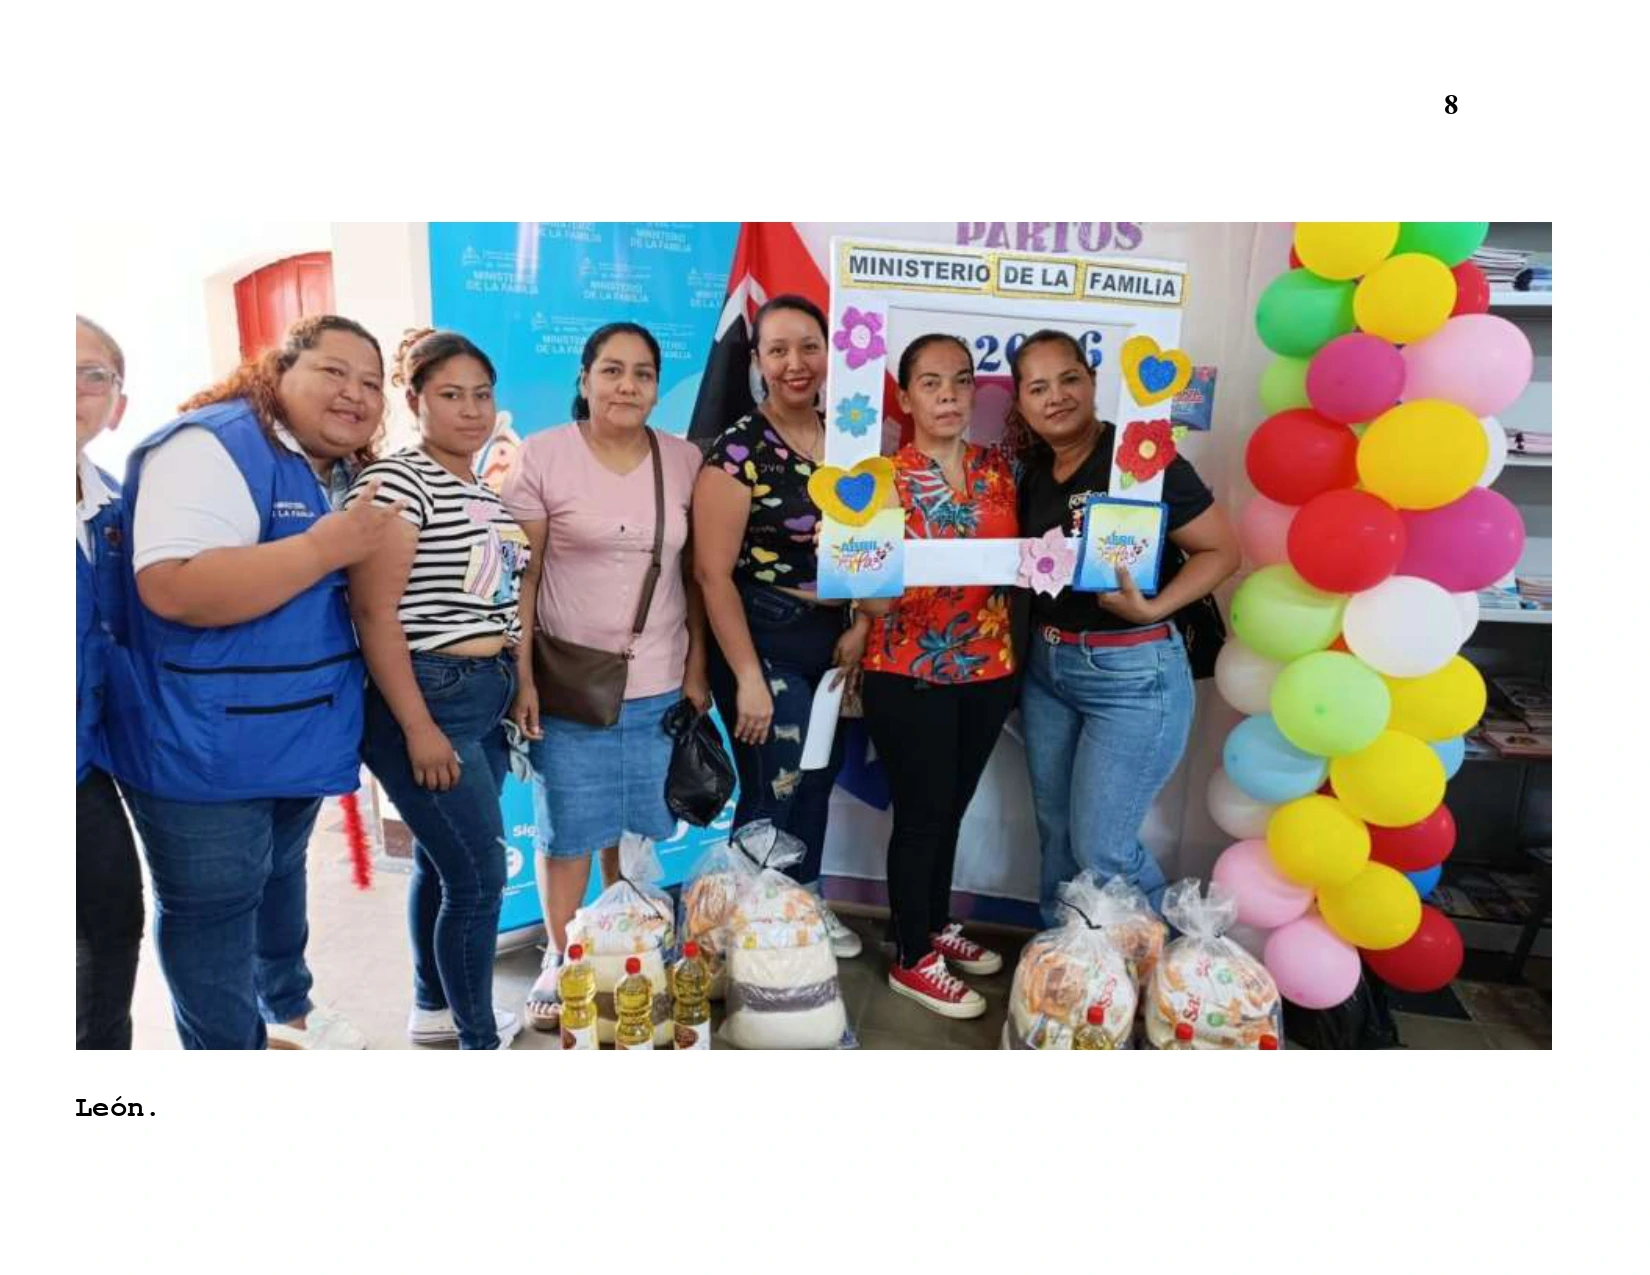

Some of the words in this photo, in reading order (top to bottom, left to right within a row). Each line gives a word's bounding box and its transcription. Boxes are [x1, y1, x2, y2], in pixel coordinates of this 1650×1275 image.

[849, 255, 990, 283] MINISTERIO
[1004, 266, 1034, 285] DE
[1041, 269, 1069, 288] LA
